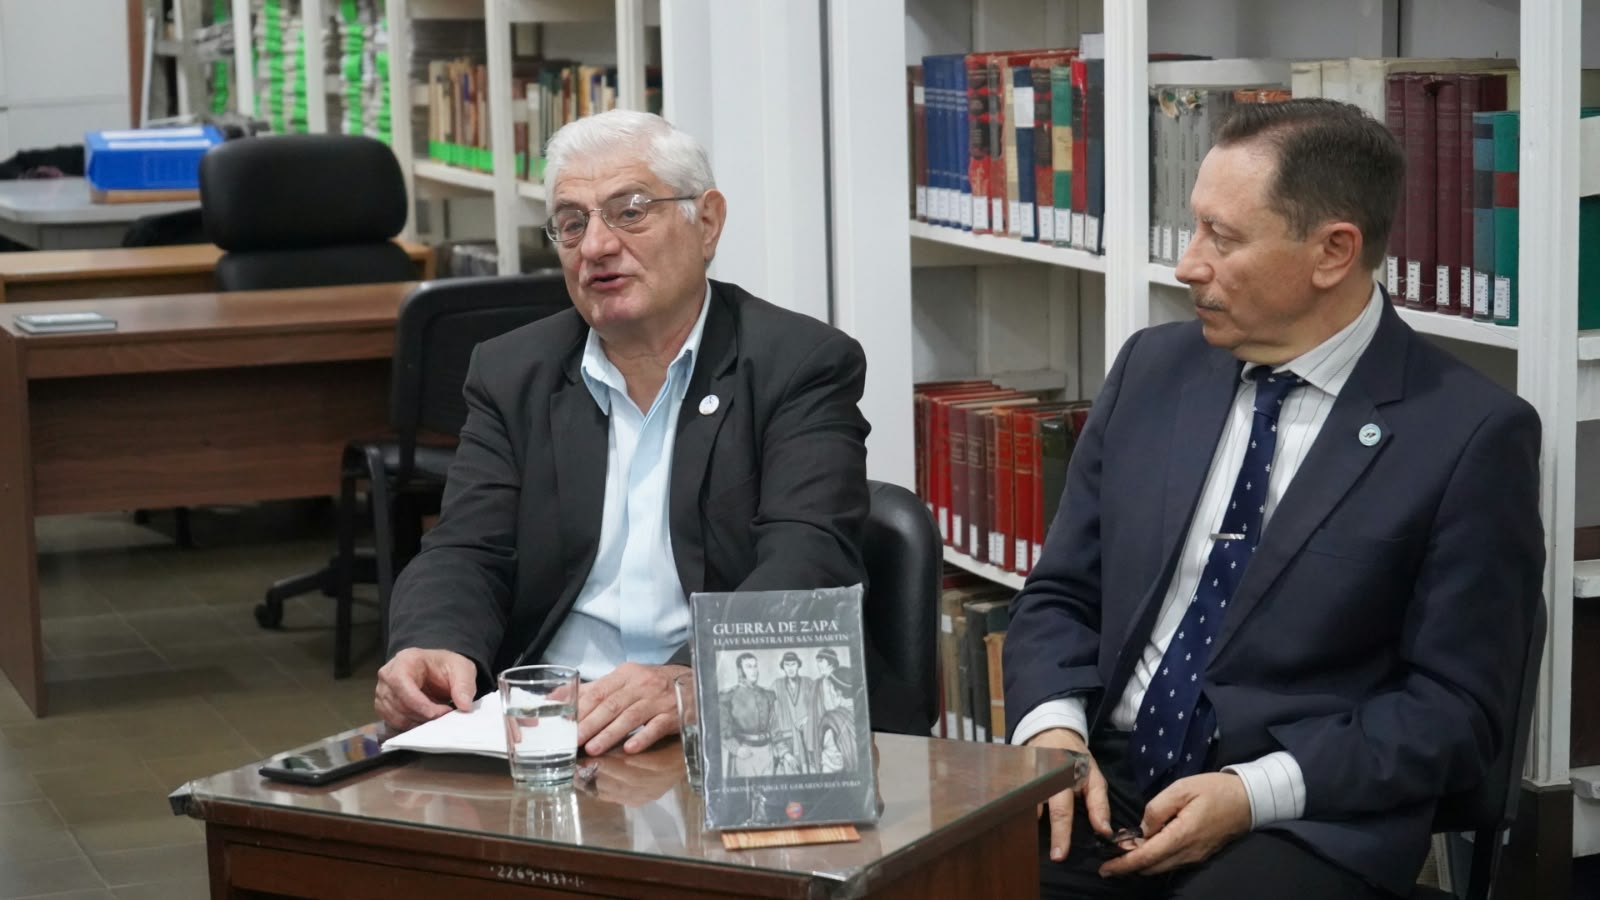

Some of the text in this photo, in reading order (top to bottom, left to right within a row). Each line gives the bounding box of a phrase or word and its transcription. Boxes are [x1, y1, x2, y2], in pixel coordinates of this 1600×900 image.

[712, 619, 839, 635] GUERRA DE ZAPA
[713, 637, 739, 646] LLAVE
[742, 635, 783, 645] MAESTRA
[783, 635, 795, 643] DE
[796, 634, 813, 643] SAN
